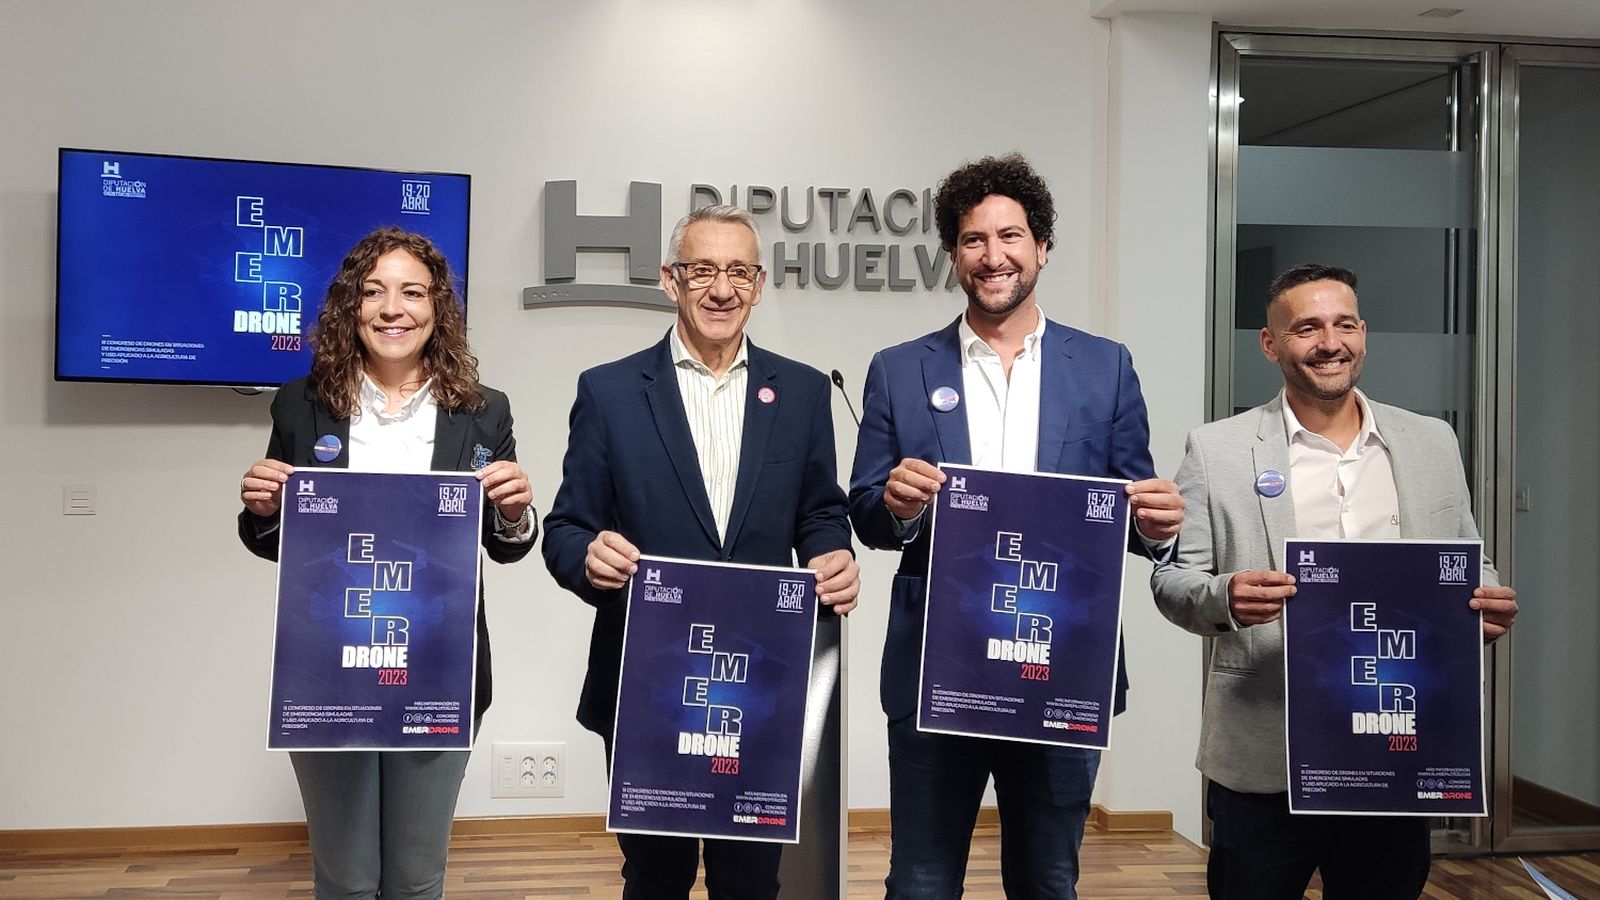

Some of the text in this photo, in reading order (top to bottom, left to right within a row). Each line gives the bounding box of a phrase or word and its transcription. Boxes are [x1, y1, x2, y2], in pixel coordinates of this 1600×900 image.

[103, 161, 120, 175] H
[115, 186, 146, 194] HUELVA
[401, 196, 430, 211] ABRIL
[689, 183, 936, 237] DIPUTACI
[773, 241, 958, 292] HUELV
[233, 310, 301, 335] DRONE
[271, 335, 301, 351] 2023
[299, 480, 314, 492] H
[951, 476, 966, 489] H
[438, 499, 468, 513] ABRIL
[961, 499, 989, 507] HUELVA
[1086, 504, 1115, 520] ABRIL
[1300, 551, 1314, 562] H
[646, 569, 661, 581] H
[1439, 568, 1468, 581] ABRIL
[655, 592, 683, 600] HUELVA
[777, 595, 805, 610] ABRIL
[341, 646, 409, 668] DRONE
[986, 638, 1052, 665] DRONE
[378, 670, 408, 685] 2023
[1021, 664, 1050, 682] 2023
[939, 696, 971, 704] EMERGENCIAS
[402, 726, 459, 734] EMERDRONE
[1043, 720, 1098, 733] EMERDRONE
[1352, 712, 1417, 735] DRONE
[677, 732, 741, 758] DRONE
[1389, 736, 1418, 752] 2023
[710, 758, 740, 775] 2023
[733, 815, 787, 826] EMERDRONE
